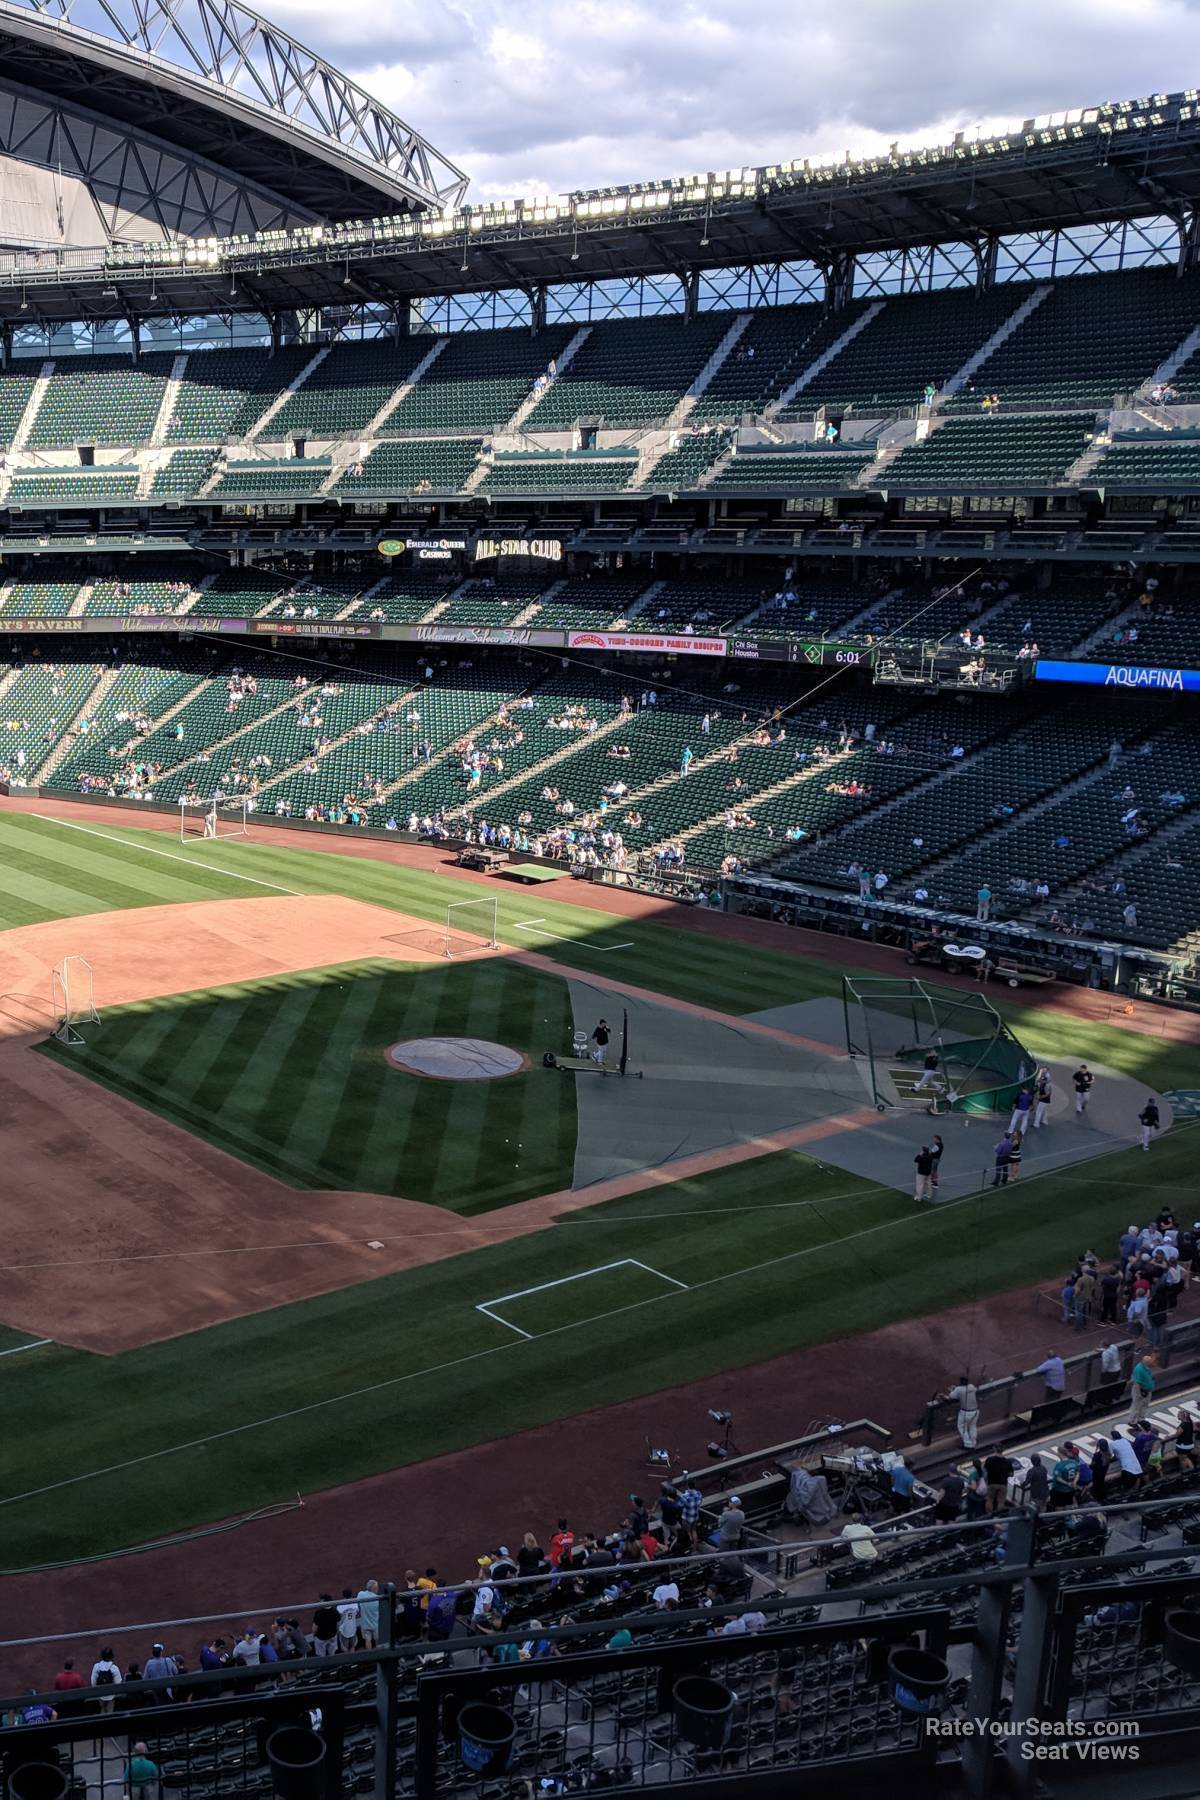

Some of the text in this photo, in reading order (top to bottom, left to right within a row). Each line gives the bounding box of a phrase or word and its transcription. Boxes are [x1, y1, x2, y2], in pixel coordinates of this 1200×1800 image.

[406, 539, 466, 549] EMERALD QUEEN
[501, 540, 530, 556] STAR
[531, 540, 562, 561] CLUB
[27, 620, 83, 630] TAVERN
[120, 618, 159, 632] Welcome
[168, 617, 197, 632] Safeco
[198, 618, 221, 632] Field
[416, 626, 455, 642] Welcome
[467, 627, 500, 644] Safeco
[502, 629, 532, 645] Field
[667, 639, 691, 648] FAMILY
[734, 649, 759, 658] Houston
[835, 650, 860, 664] 6:01
[1105, 666, 1184, 690] AQUAFINA
